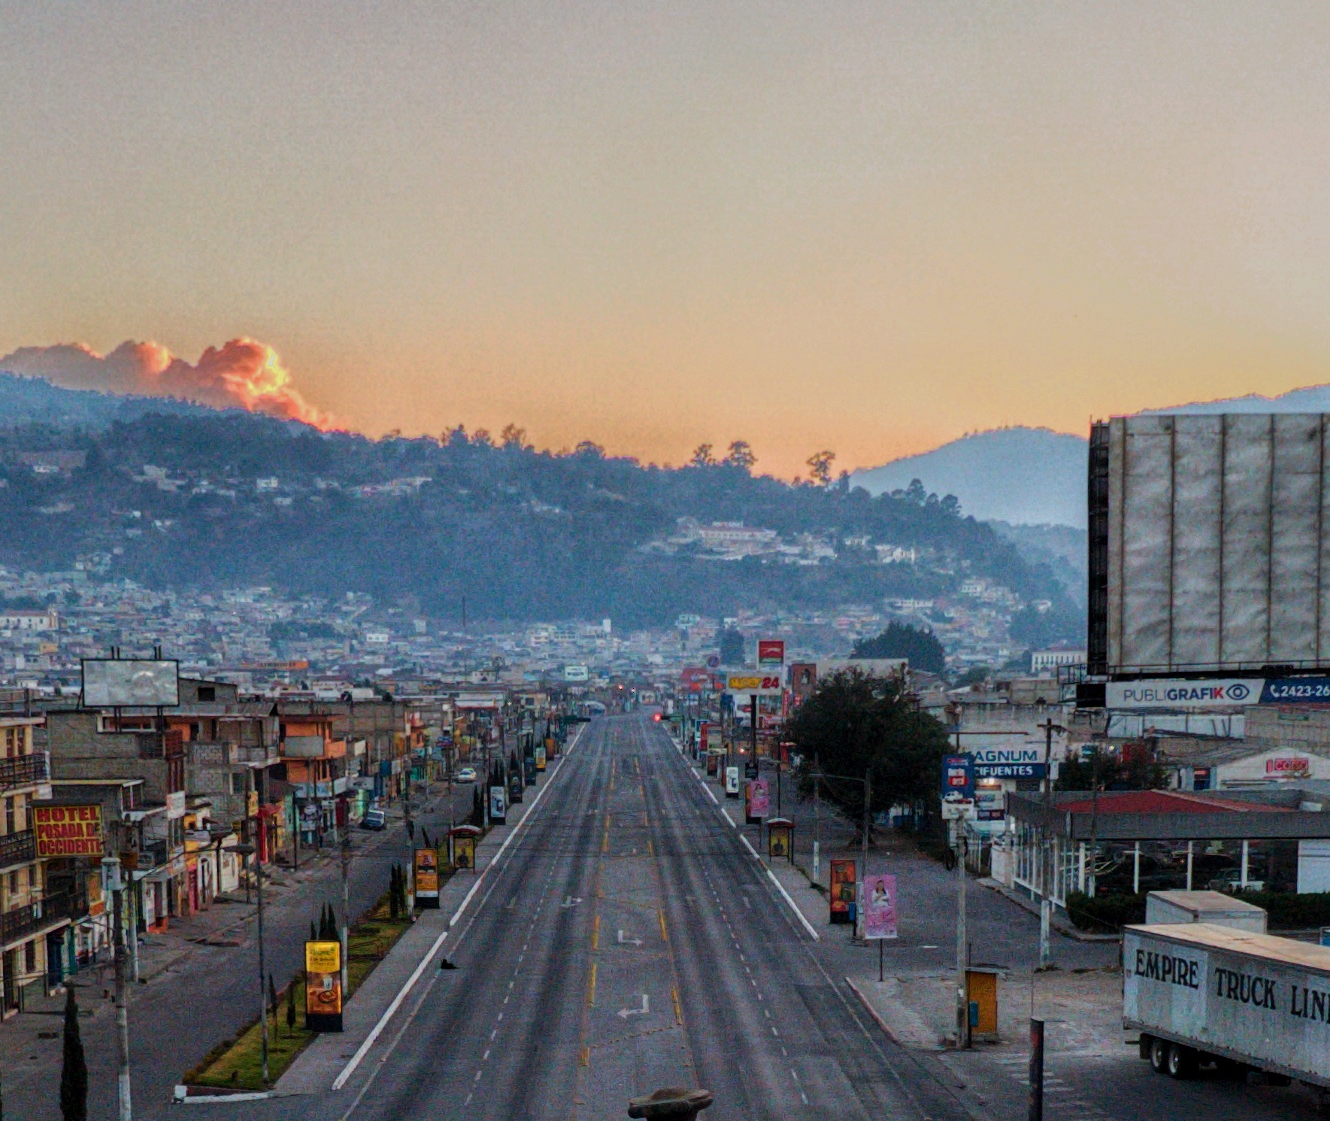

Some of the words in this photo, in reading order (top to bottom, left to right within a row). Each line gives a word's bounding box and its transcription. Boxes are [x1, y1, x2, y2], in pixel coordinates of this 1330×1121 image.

[1123, 686, 1224, 702] PUBLIGRAFIK
[37, 806, 100, 823] HOTEL
[37, 822, 85, 839] POSADA
[38, 838, 102, 855] OCCIDENTE
[1134, 949, 1199, 990] EMPIRE
[1215, 967, 1276, 1010] TRUCK
